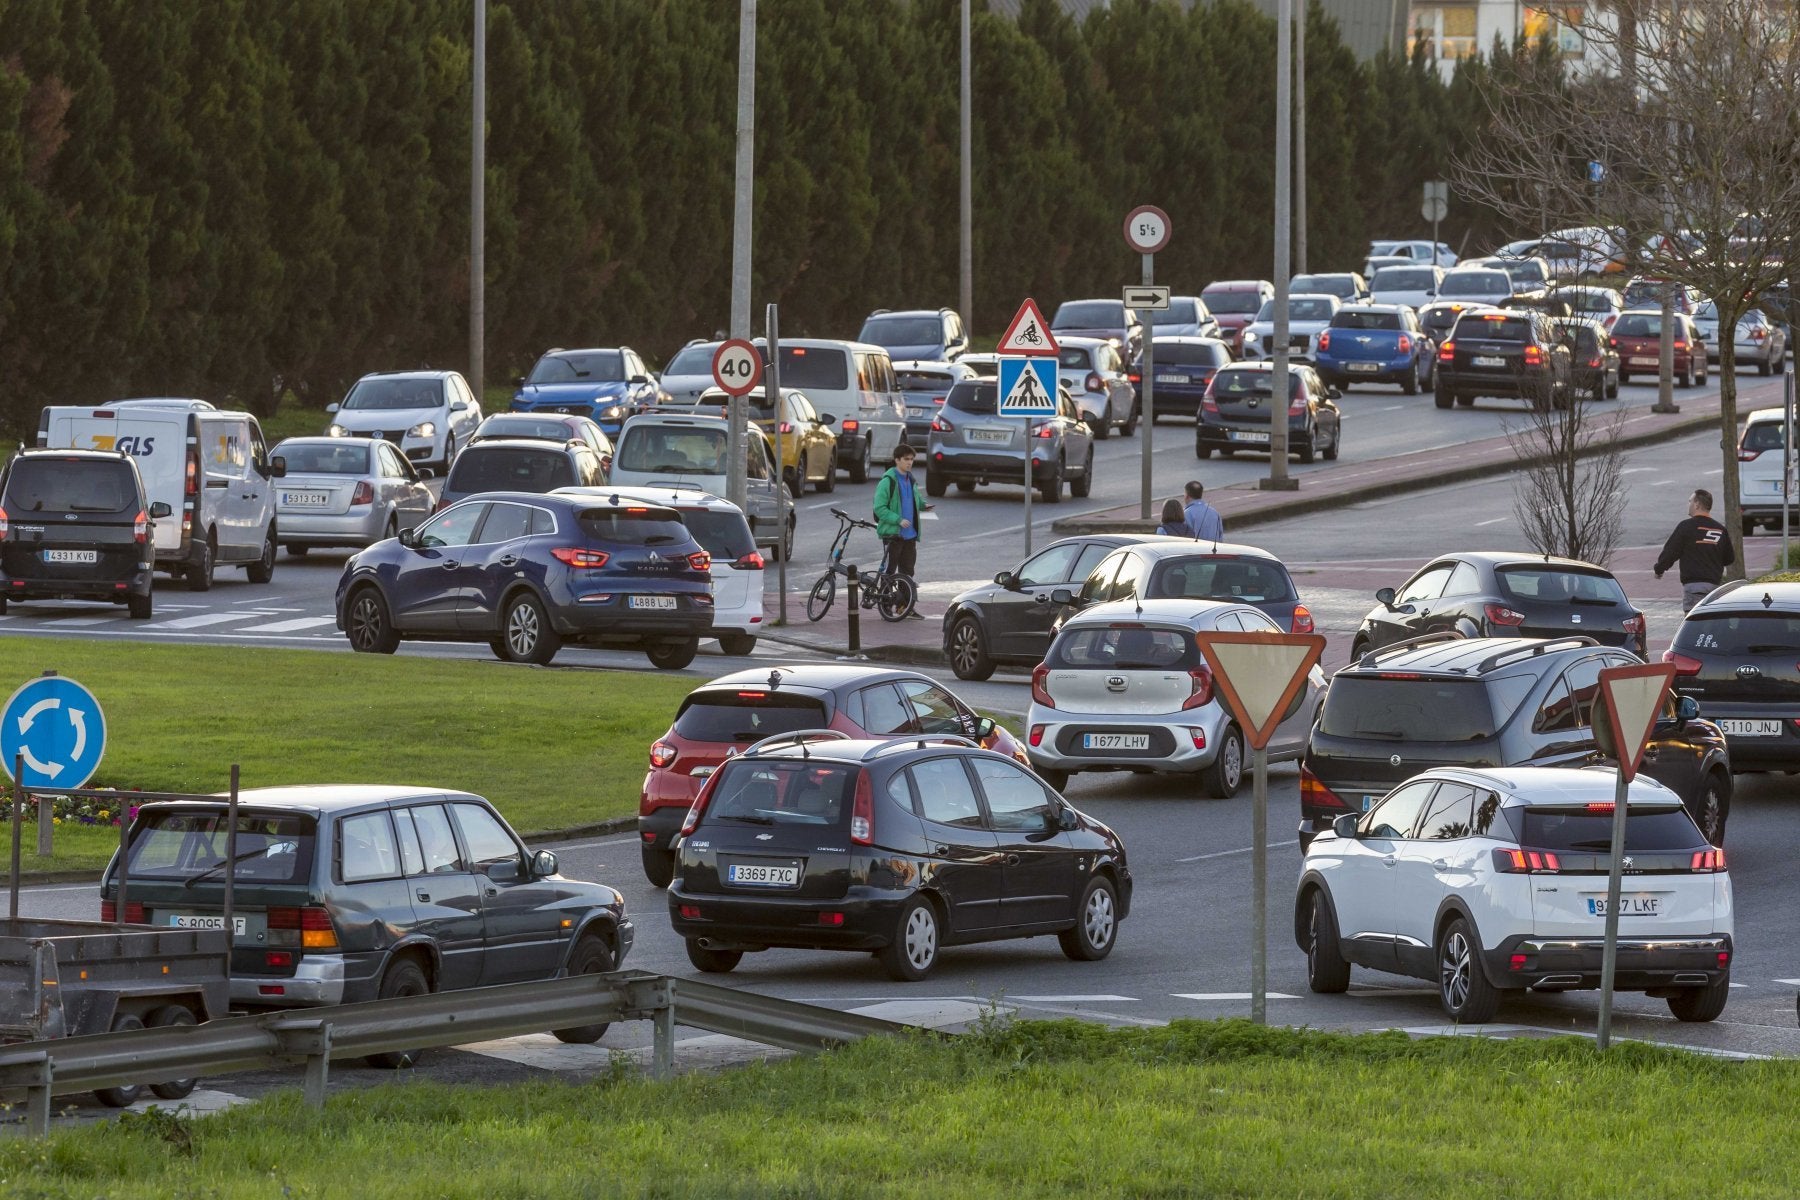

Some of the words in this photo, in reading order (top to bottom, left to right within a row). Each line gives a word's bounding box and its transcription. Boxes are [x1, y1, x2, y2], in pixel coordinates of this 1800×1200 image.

[721, 358, 751, 378] 40
[116, 436, 154, 456] GLS
[288, 494, 308, 502] 5313
[52, 552, 73, 560] 4331
[76, 552, 94, 560] KVB
[634, 598, 656, 608] 4888
[658, 599, 674, 608] LJH
[1723, 722, 1752, 732] 5110
[1757, 722, 1779, 733] JNJ
[1094, 736, 1120, 746] 1677
[1124, 736, 1146, 747] LHV
[738, 868, 766, 880] 3369
[770, 868, 792, 882] FXC
[1634, 899, 1658, 912] LKF
